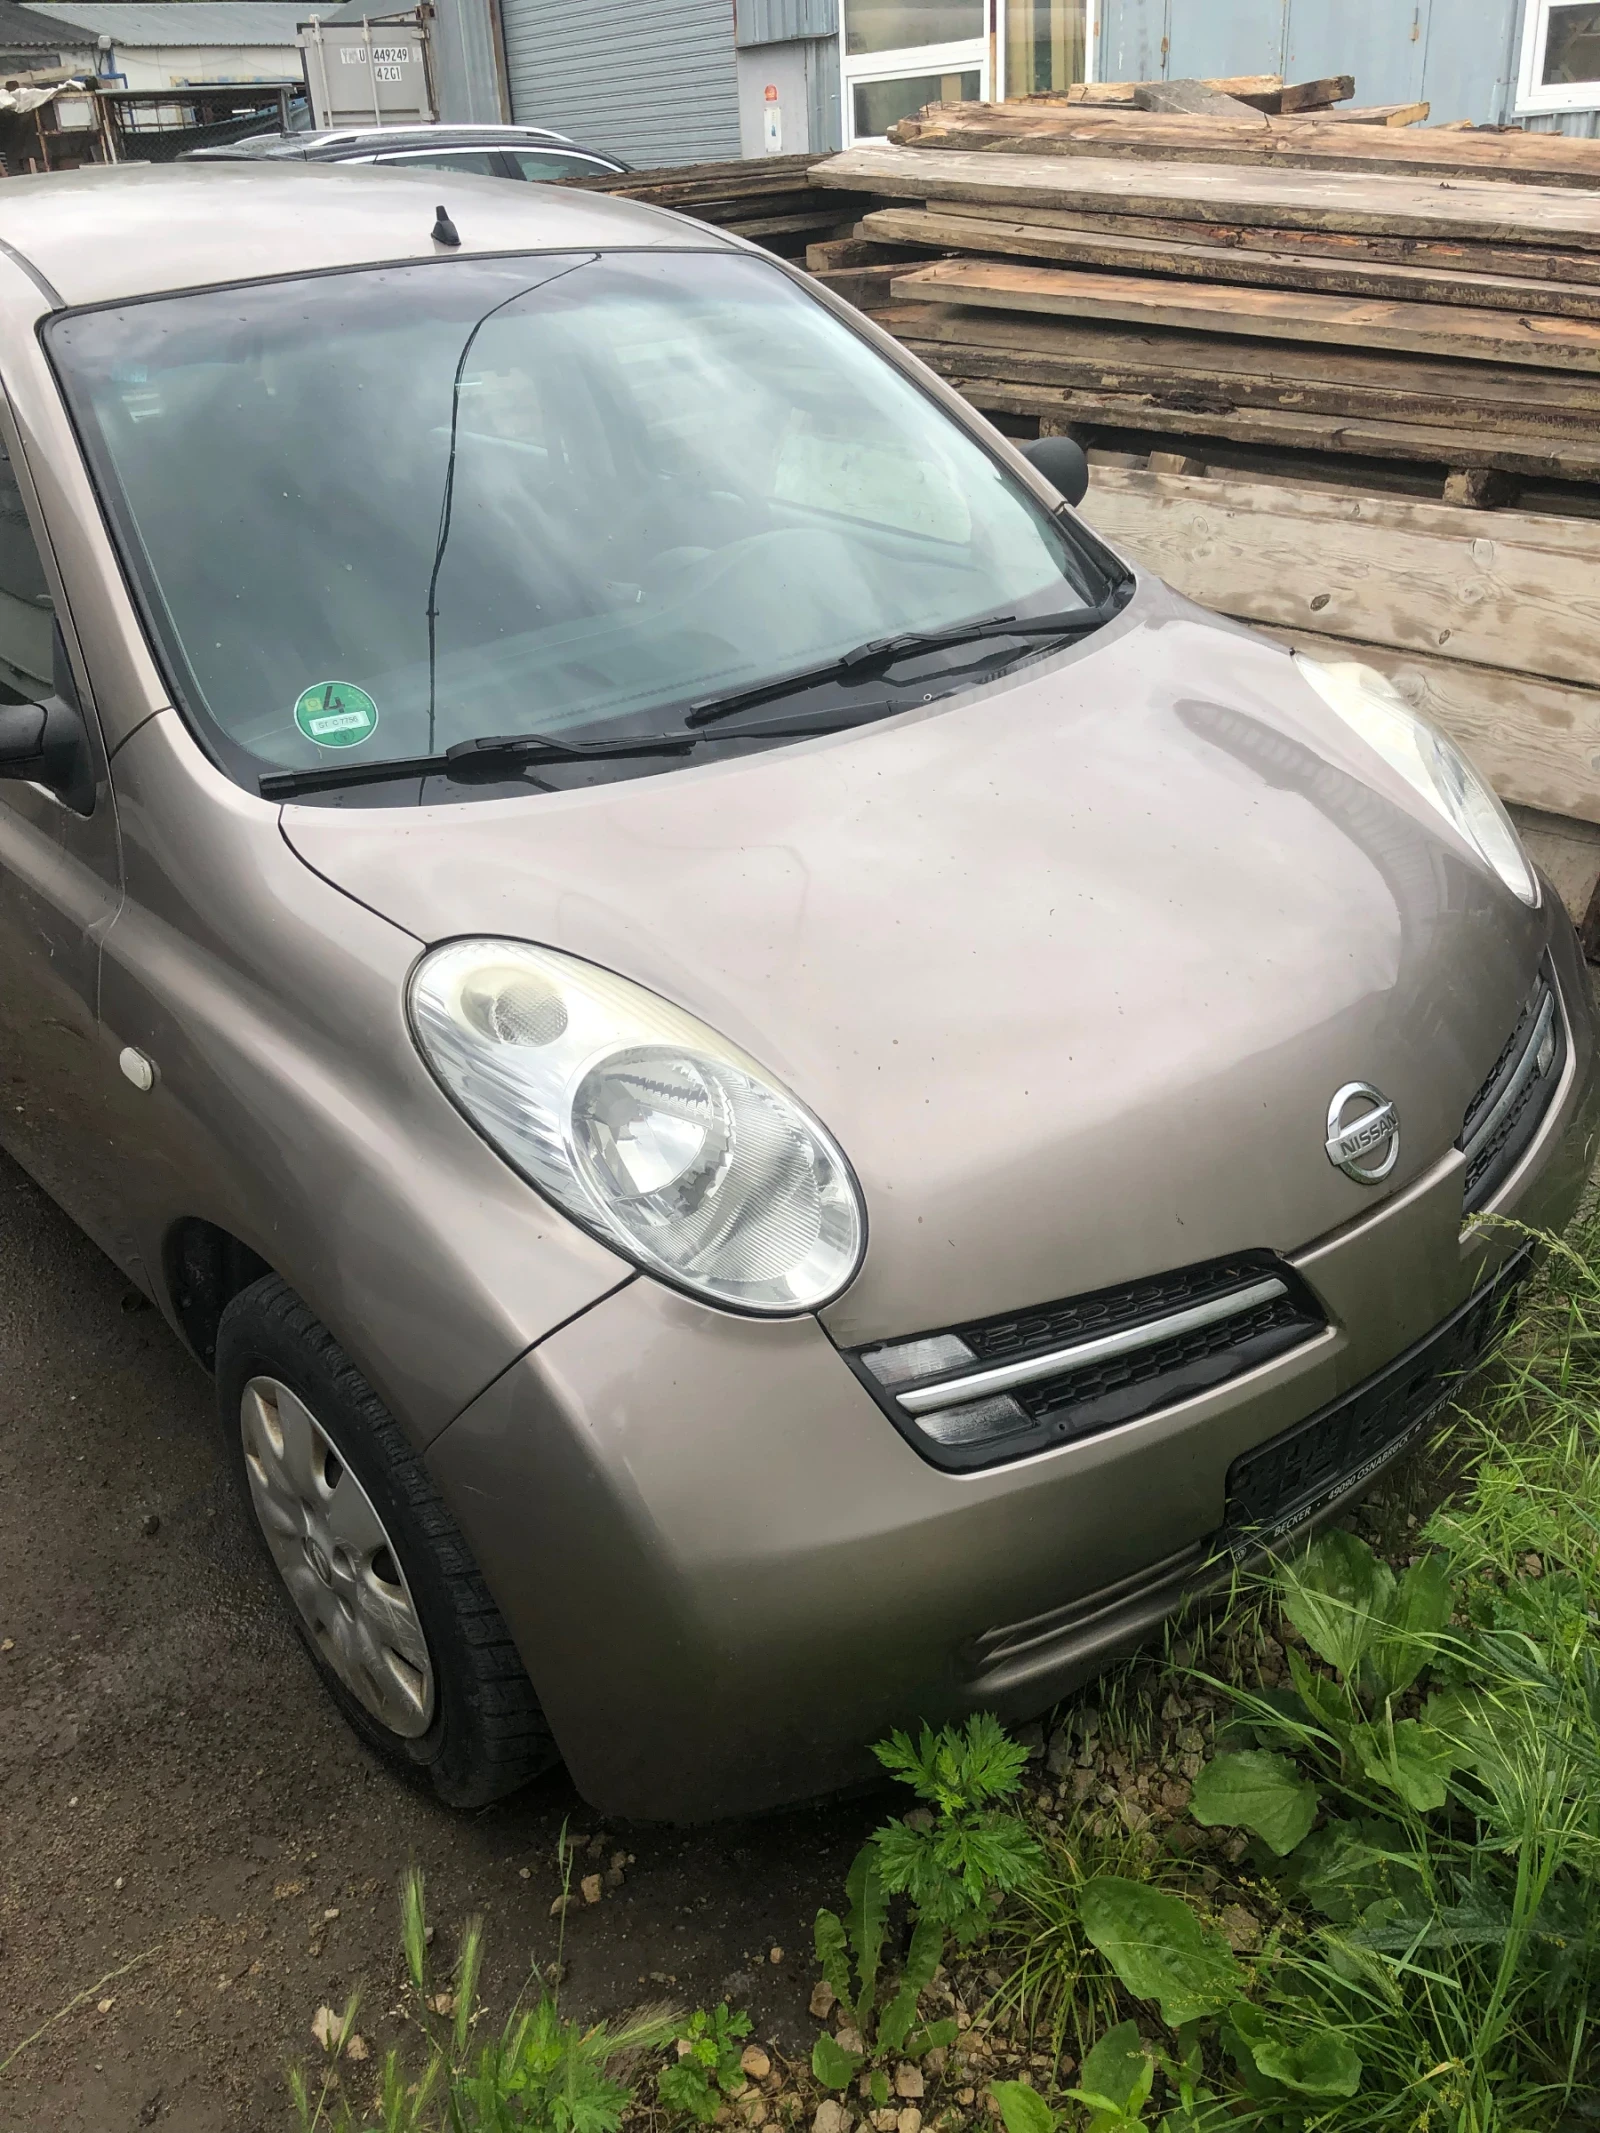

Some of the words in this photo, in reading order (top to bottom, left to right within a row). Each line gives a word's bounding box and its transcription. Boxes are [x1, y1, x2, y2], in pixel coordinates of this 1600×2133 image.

[373, 48, 408, 62] 449249
[377, 67, 401, 80] 42G1
[1340, 1111, 1399, 1157] NISSAN
[1274, 1505, 1312, 1537] BECKER
[1328, 1477, 1356, 1499] 49090
